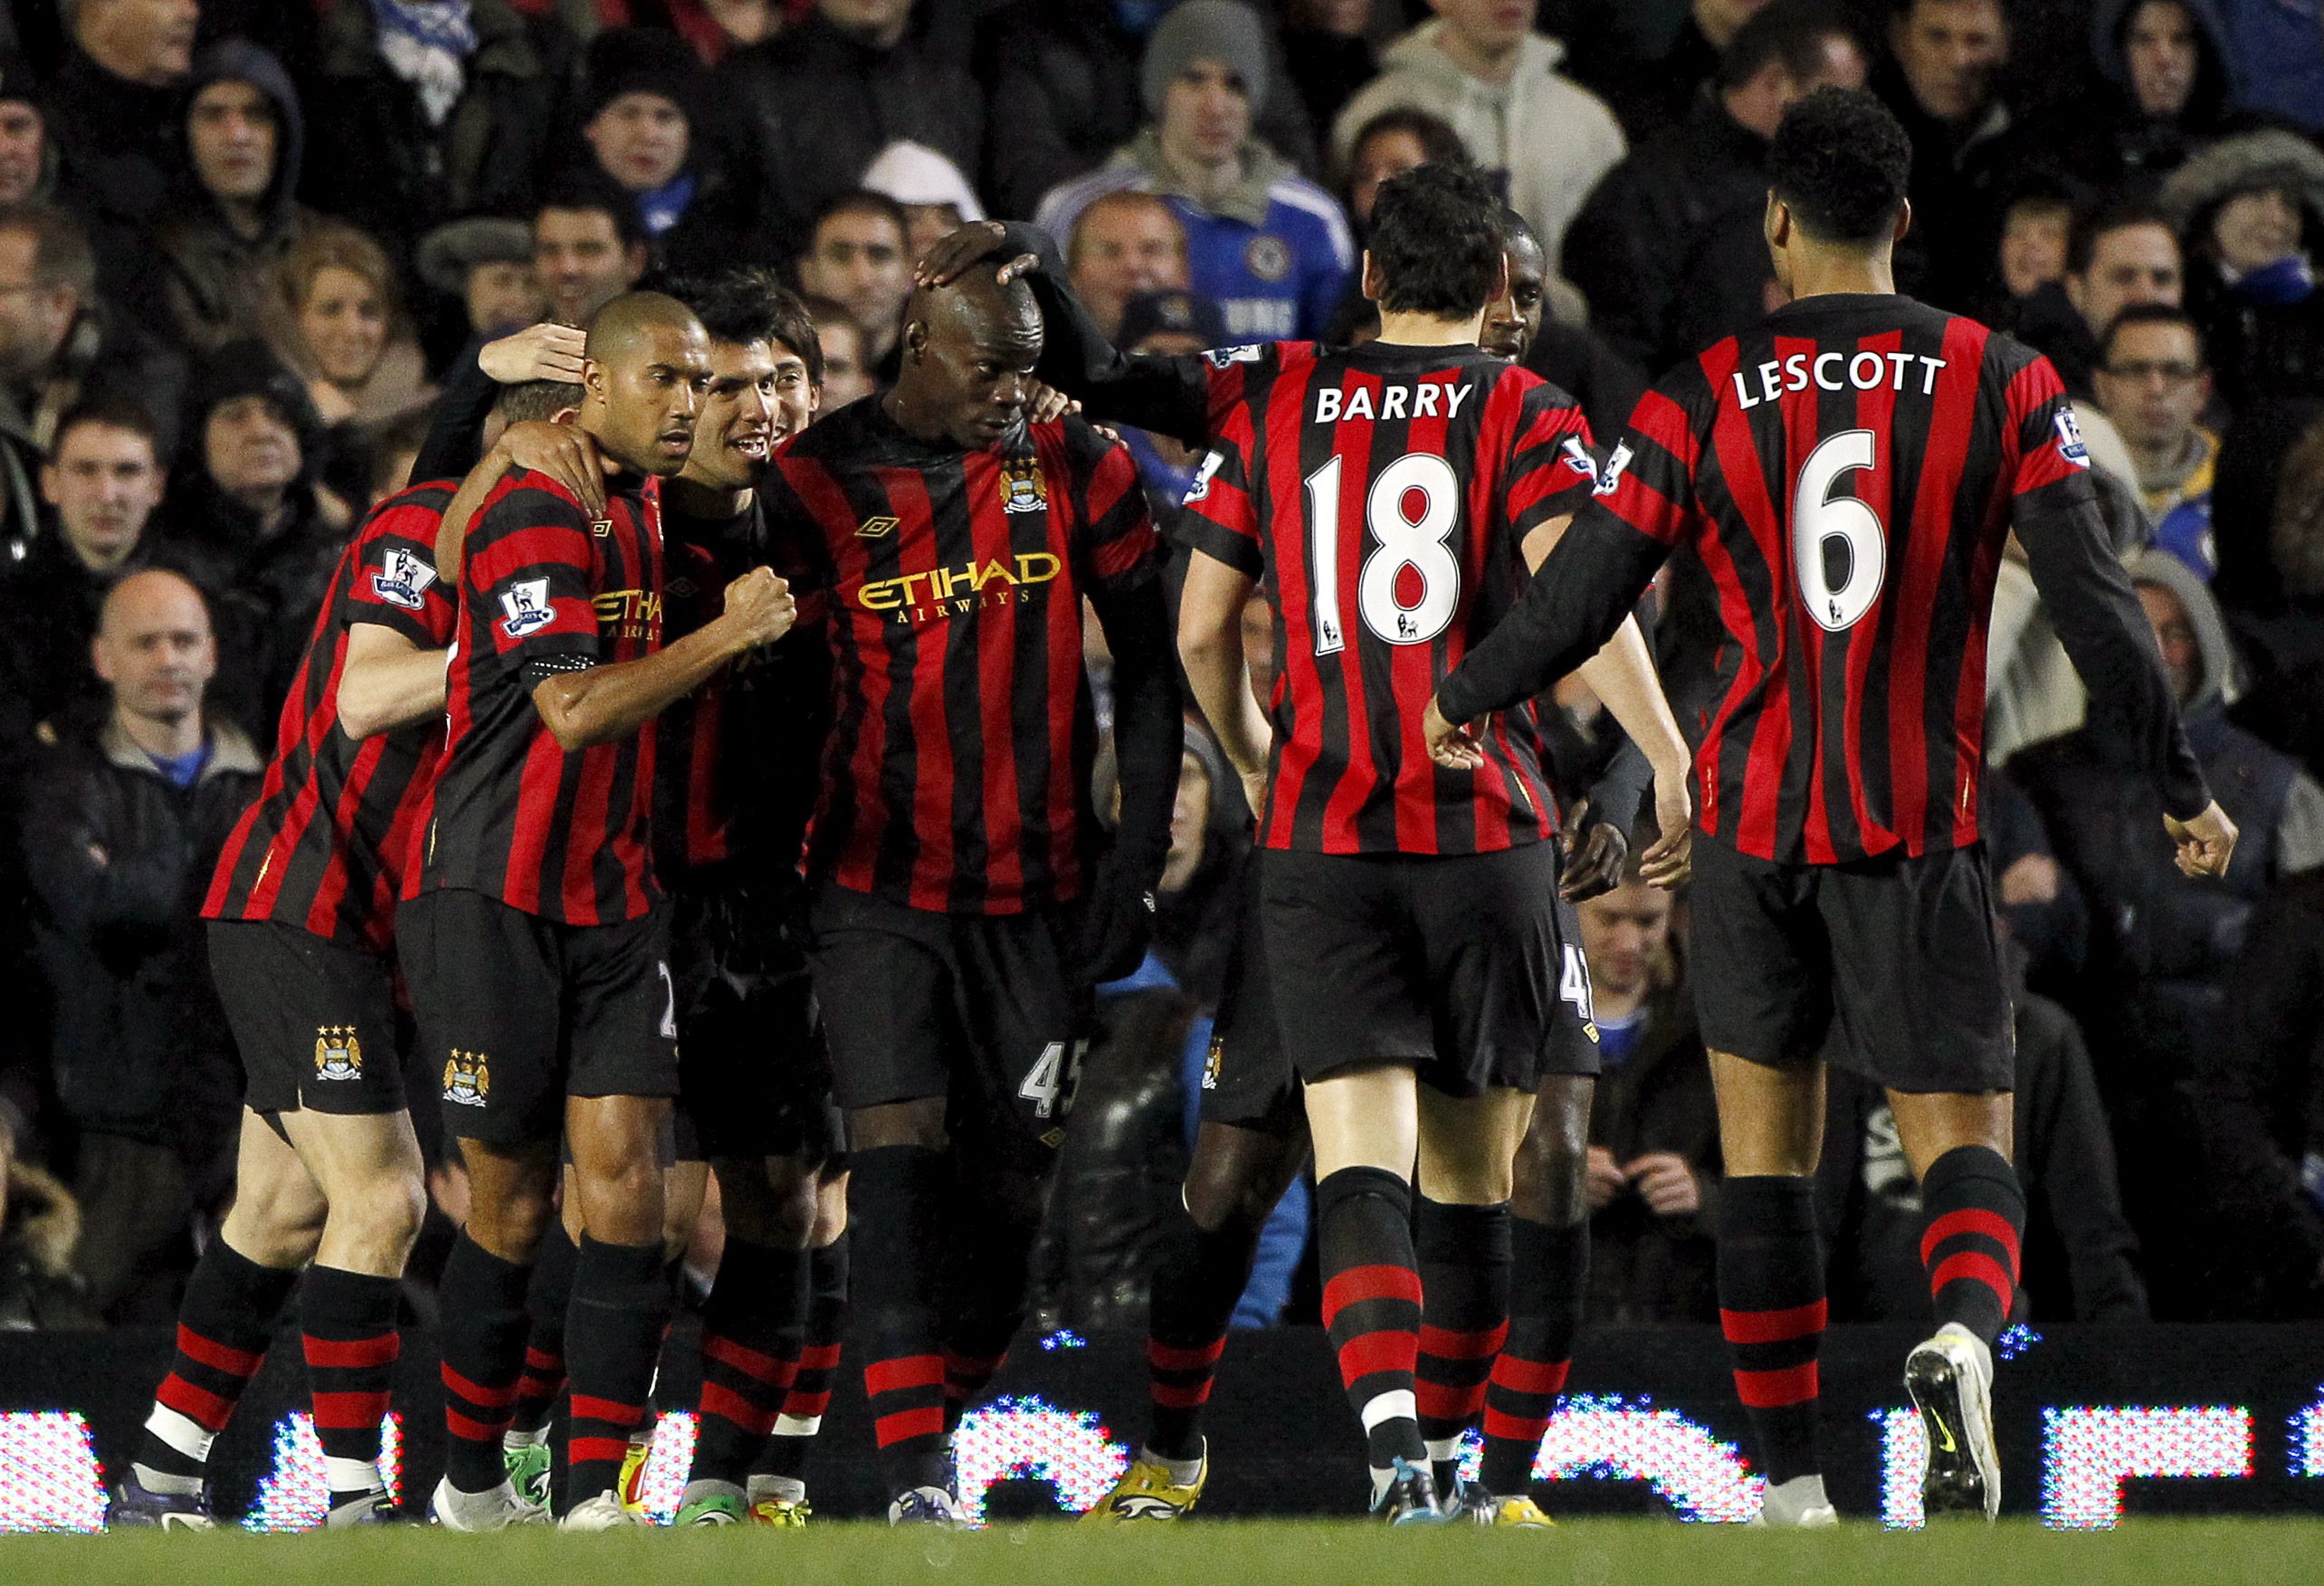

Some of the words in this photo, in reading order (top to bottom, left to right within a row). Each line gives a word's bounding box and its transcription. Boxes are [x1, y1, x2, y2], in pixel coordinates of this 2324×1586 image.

[1315, 384, 1472, 424] BARRY
[1733, 351, 1947, 409] LESCOTT
[1305, 453, 1460, 656] 18
[1793, 429, 1886, 632] 6
[858, 551, 1062, 610] ETIHAD
[897, 590, 1030, 623] AIRWAYS
[1559, 943, 1593, 1023] 4
